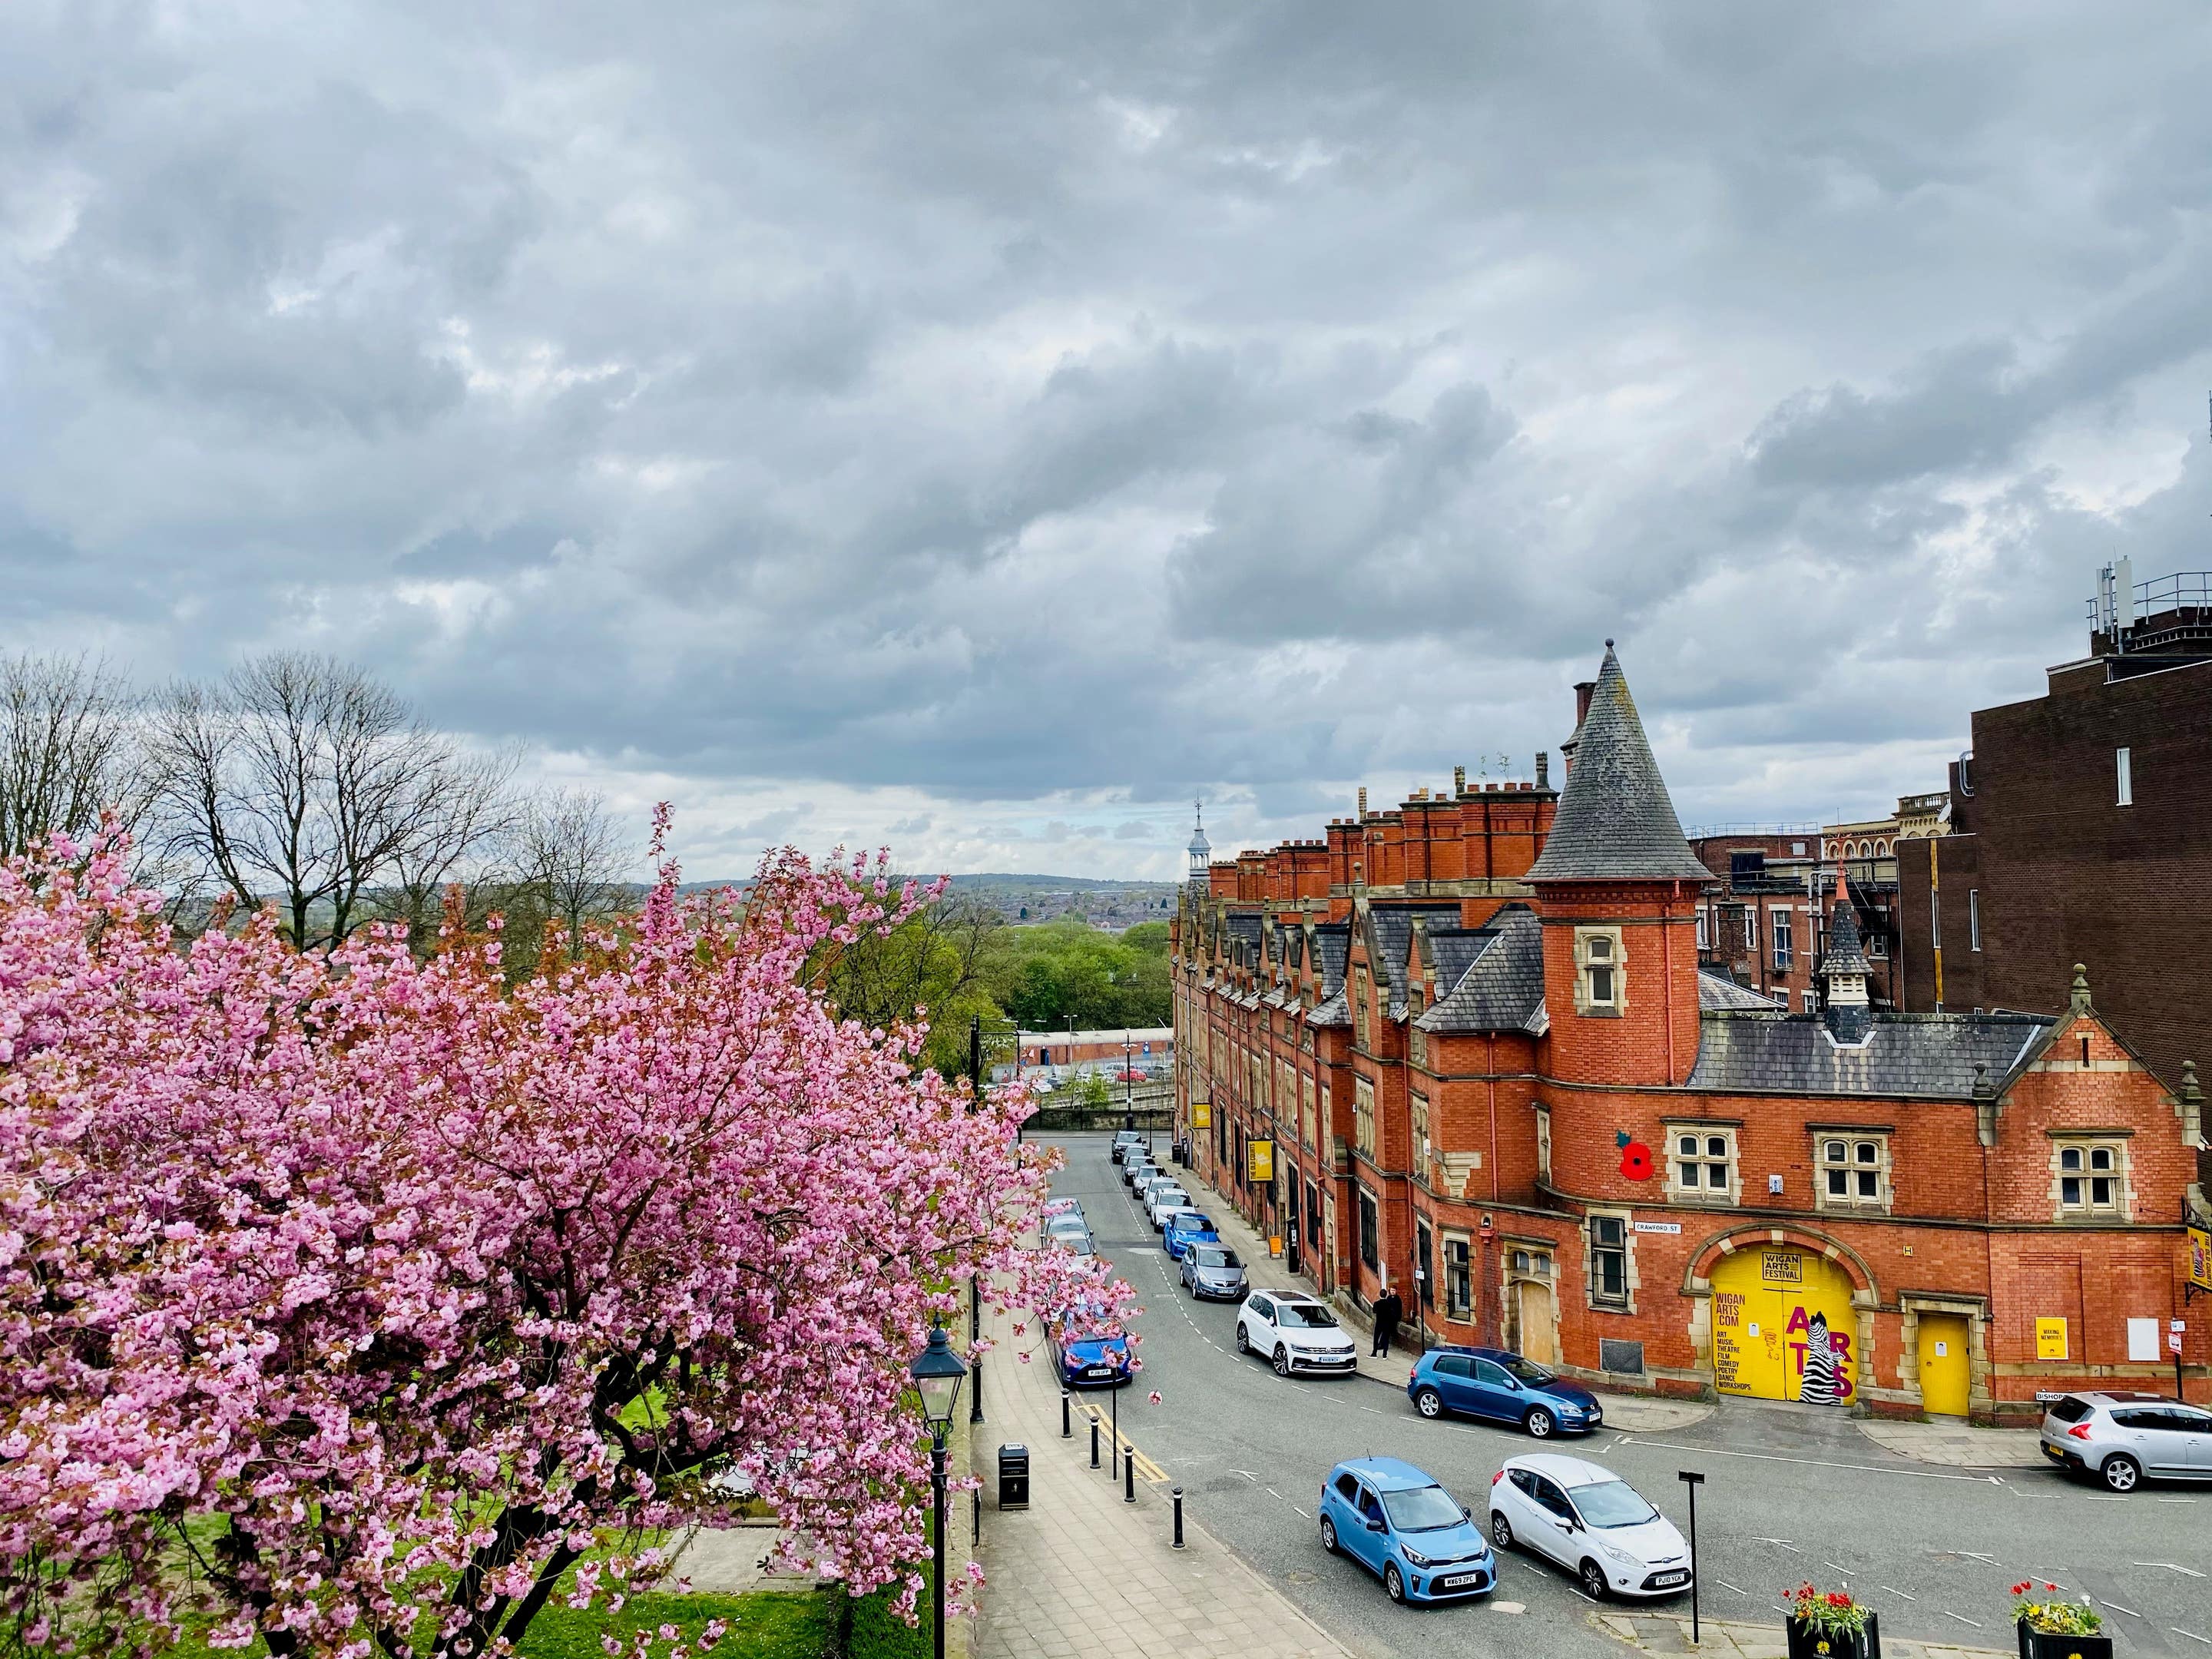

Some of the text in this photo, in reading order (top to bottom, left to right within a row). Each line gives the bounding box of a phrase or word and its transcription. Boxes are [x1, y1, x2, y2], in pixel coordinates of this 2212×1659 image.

[1765, 1253, 1799, 1263] WIGAN
[1765, 1262, 1790, 1270] ARTS
[1765, 1269, 1799, 1280] FESTIVAL
[1715, 1292, 1746, 1306] WIGAN
[1716, 1303, 1740, 1316] ARTS
[1717, 1314, 1739, 1327] .COM
[1717, 1345, 1740, 1353] THEATRE
[1717, 1359, 1739, 1368] COMEDY
[1717, 1366, 1737, 1375] POETRY
[1718, 1373, 1736, 1382] DANCE
[1718, 1380, 1751, 1391] WORKSHOPS
